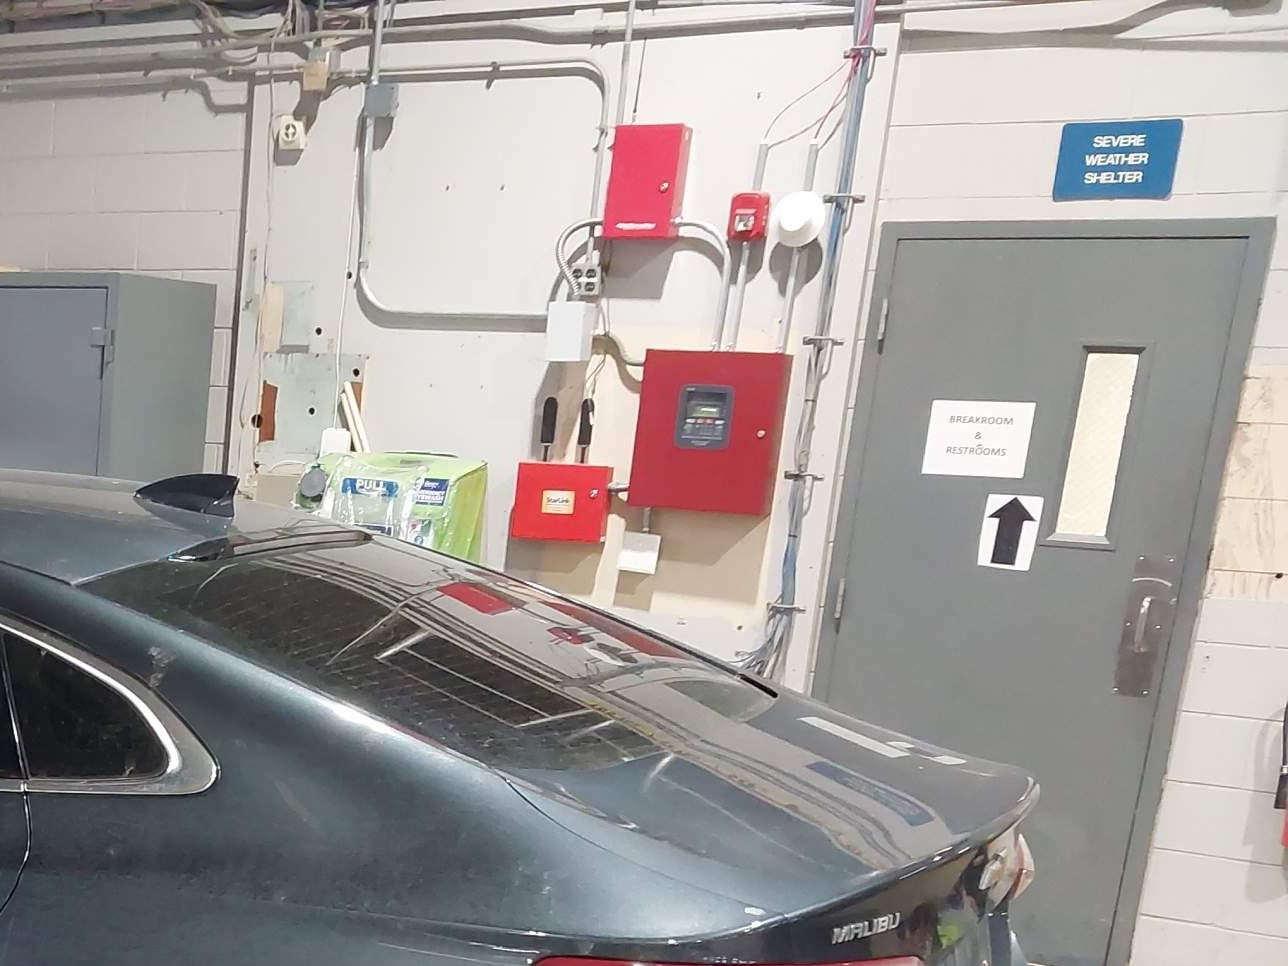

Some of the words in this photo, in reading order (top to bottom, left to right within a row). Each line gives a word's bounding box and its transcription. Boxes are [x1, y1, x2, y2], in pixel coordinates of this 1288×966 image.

[1093, 134, 1147, 148] SEVERE
[1085, 152, 1150, 166] WEATHER
[1083, 171, 1144, 184] SHELTER
[949, 415, 1014, 425] BREAKROOM
[974, 431, 982, 440] &
[945, 446, 1007, 456] RESTROOMS
[356, 479, 386, 491] PULL
[831, 912, 901, 945] MALIBU
